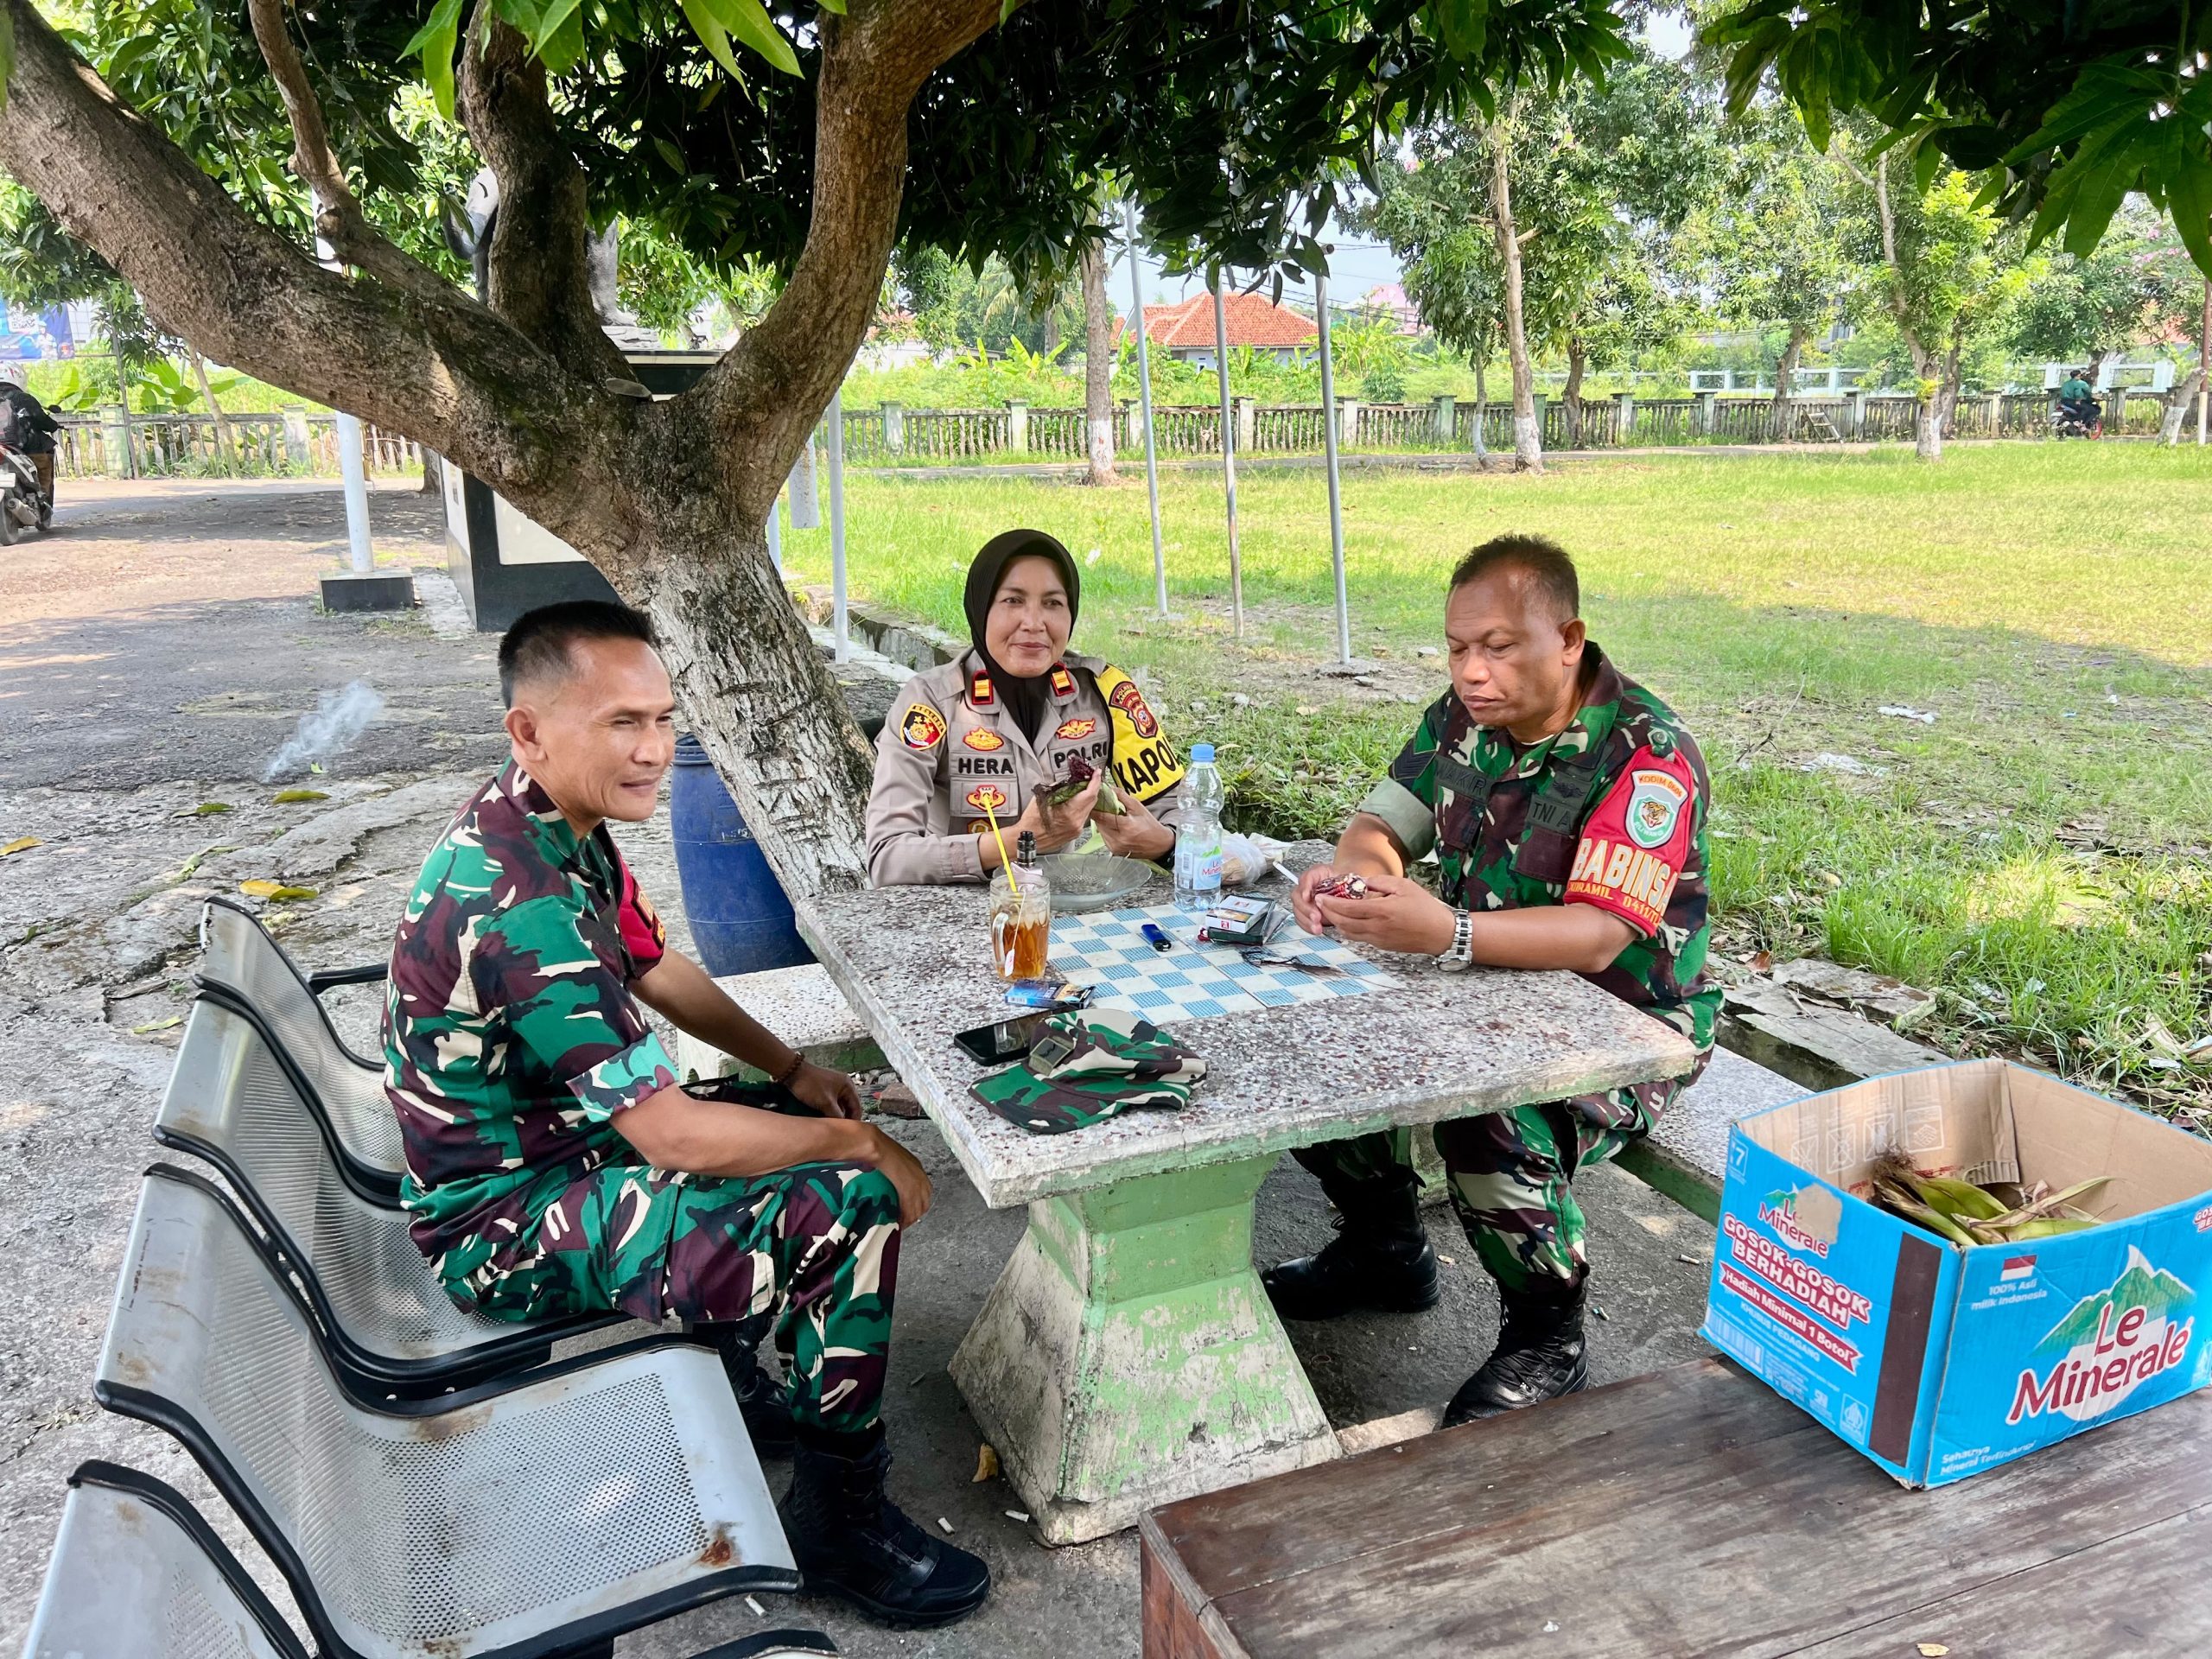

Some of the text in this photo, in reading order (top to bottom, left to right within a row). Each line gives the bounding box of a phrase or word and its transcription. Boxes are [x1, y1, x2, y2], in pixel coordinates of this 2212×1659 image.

[958, 758, 1014, 774] HERA
[1638, 774, 1667, 785] KODIM
[1534, 802, 1555, 823] TNI
[1569, 838, 1677, 916] BABINSA
[1758, 1202, 1828, 1257] Minerale
[1724, 1213, 1871, 1318] GOSOK-GOSOK
[1733, 1239, 1848, 1325] BERHADIAH
[1989, 1278, 2037, 1295] 100% Asli
[1725, 1269, 1759, 1300] Hadiah
[1761, 1294, 1807, 1332] Minimal
[1808, 1325, 1816, 1338] 1
[1971, 1289, 2047, 1310] milik Indonesia
[2094, 1303, 2145, 1357] Le
[2009, 1323, 2189, 1421] Minerale
[1940, 1457, 1979, 1476] Mineral
